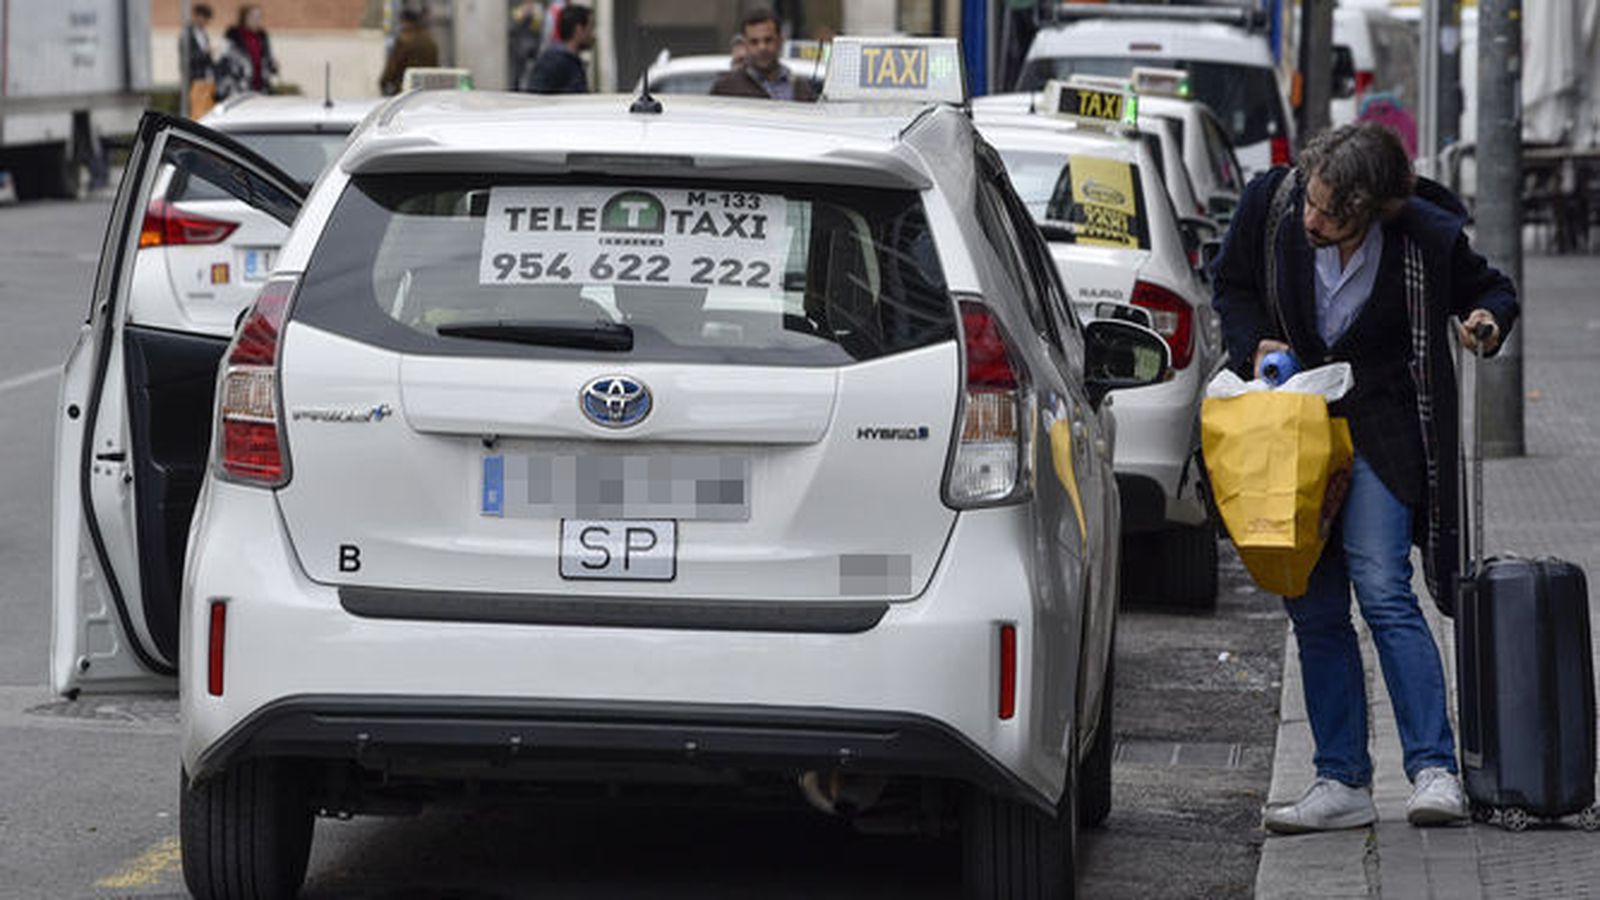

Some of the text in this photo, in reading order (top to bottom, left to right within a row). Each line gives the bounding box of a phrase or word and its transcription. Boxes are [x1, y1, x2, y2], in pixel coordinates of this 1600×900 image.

[863, 48, 927, 86] TAXI
[1077, 89, 1122, 119] TAXI
[686, 191, 761, 209] M-133
[503, 200, 768, 240] TELE T TAXI
[492, 252, 771, 288] 954 622 222
[338, 545, 362, 573] B
[579, 526, 658, 571] SP
